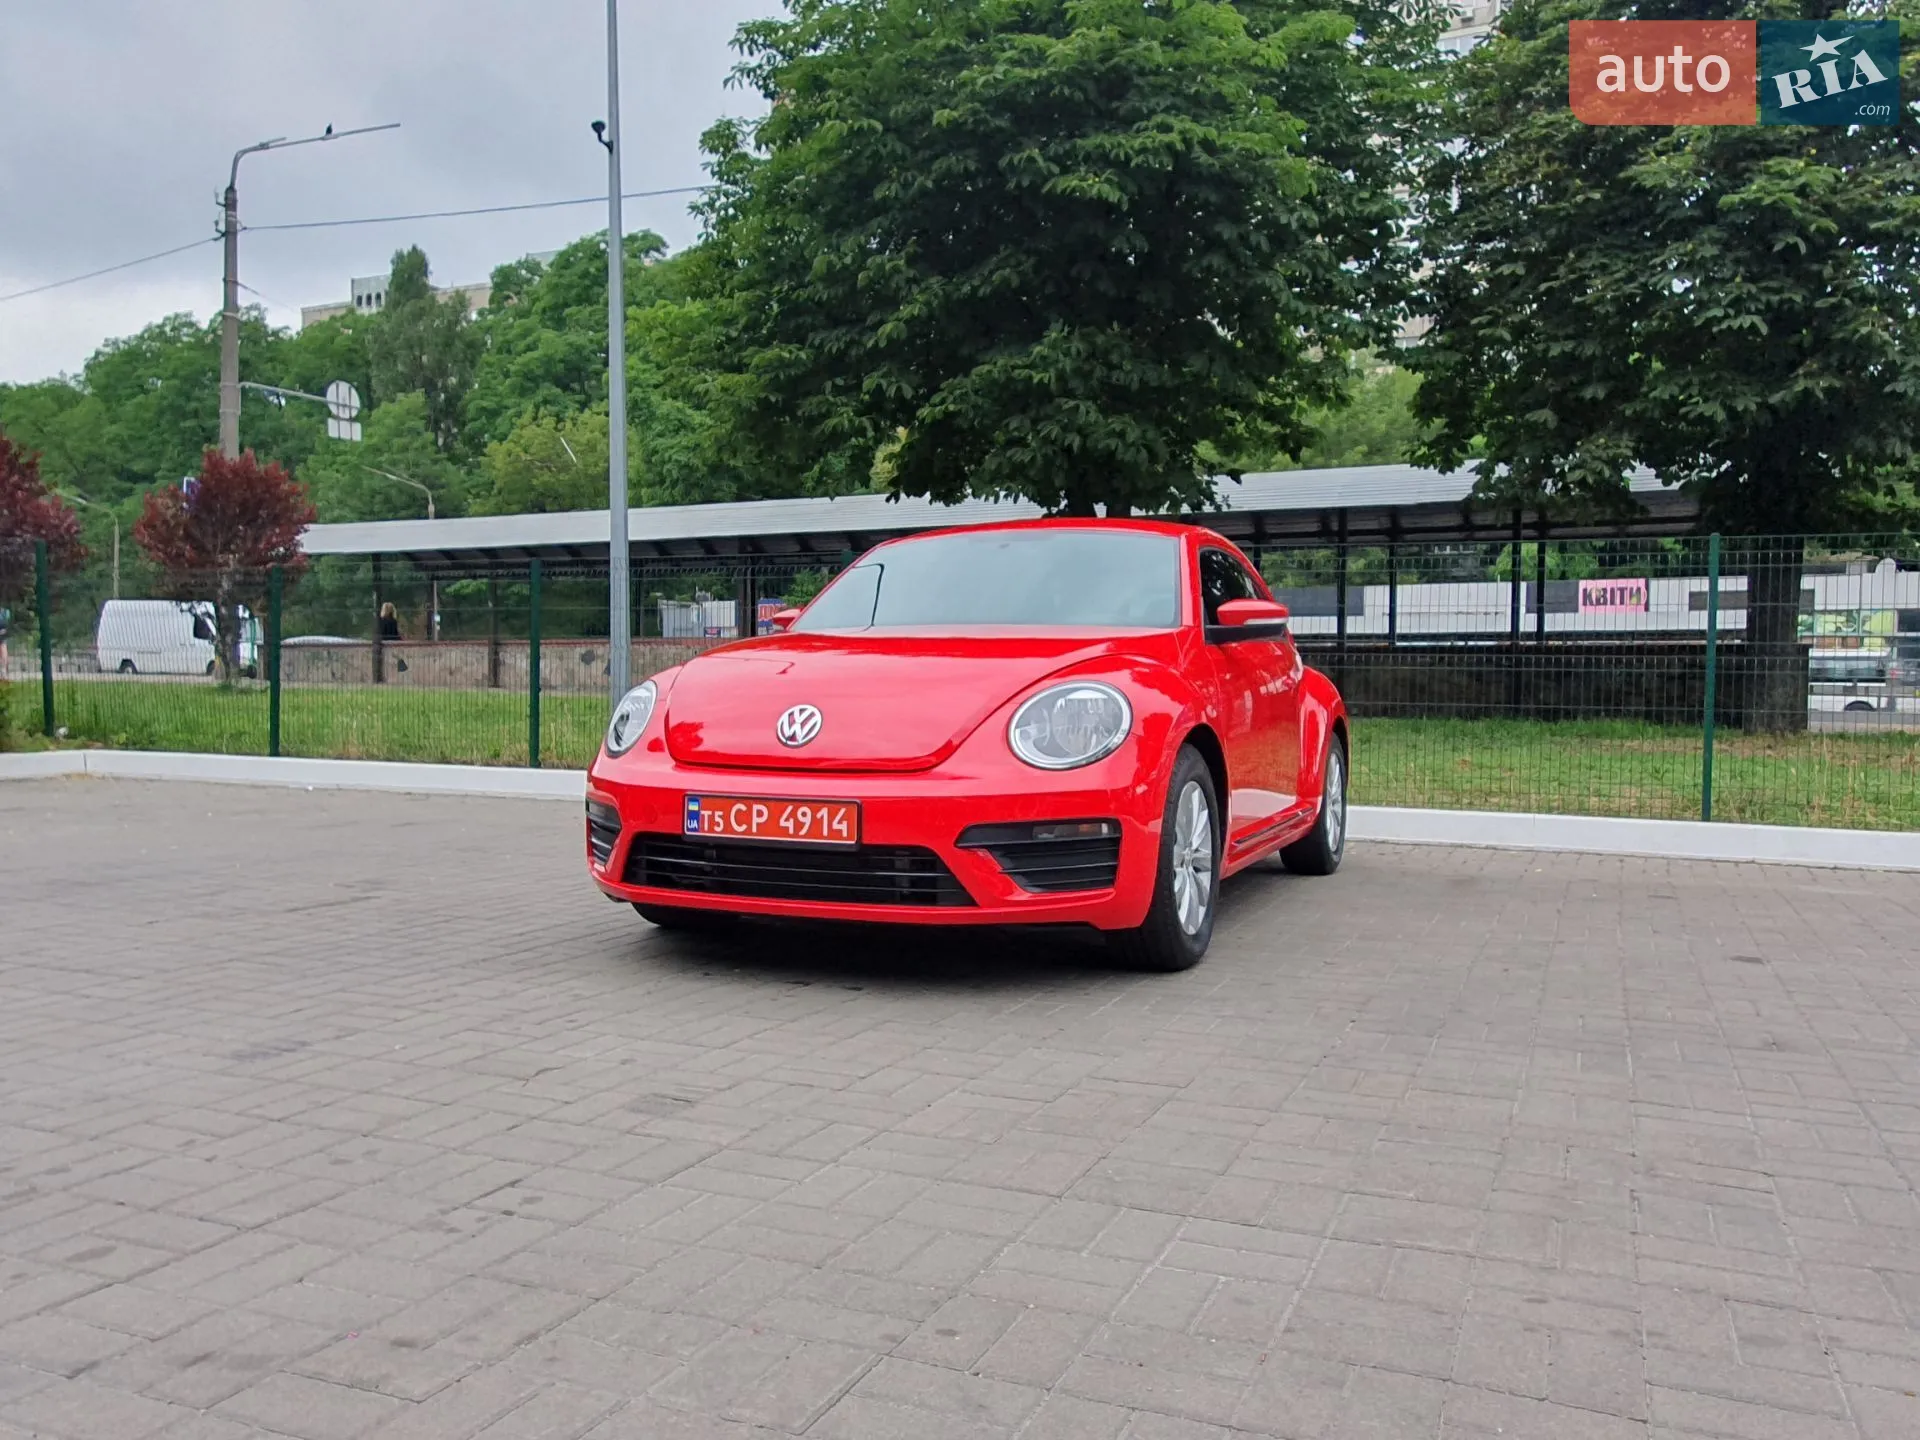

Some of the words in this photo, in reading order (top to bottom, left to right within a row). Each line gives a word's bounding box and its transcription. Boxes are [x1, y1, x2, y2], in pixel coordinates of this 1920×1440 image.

[1582, 586, 1641, 607] КВІТИ
[687, 819, 699, 829] UA
[779, 804, 848, 838] 4914
